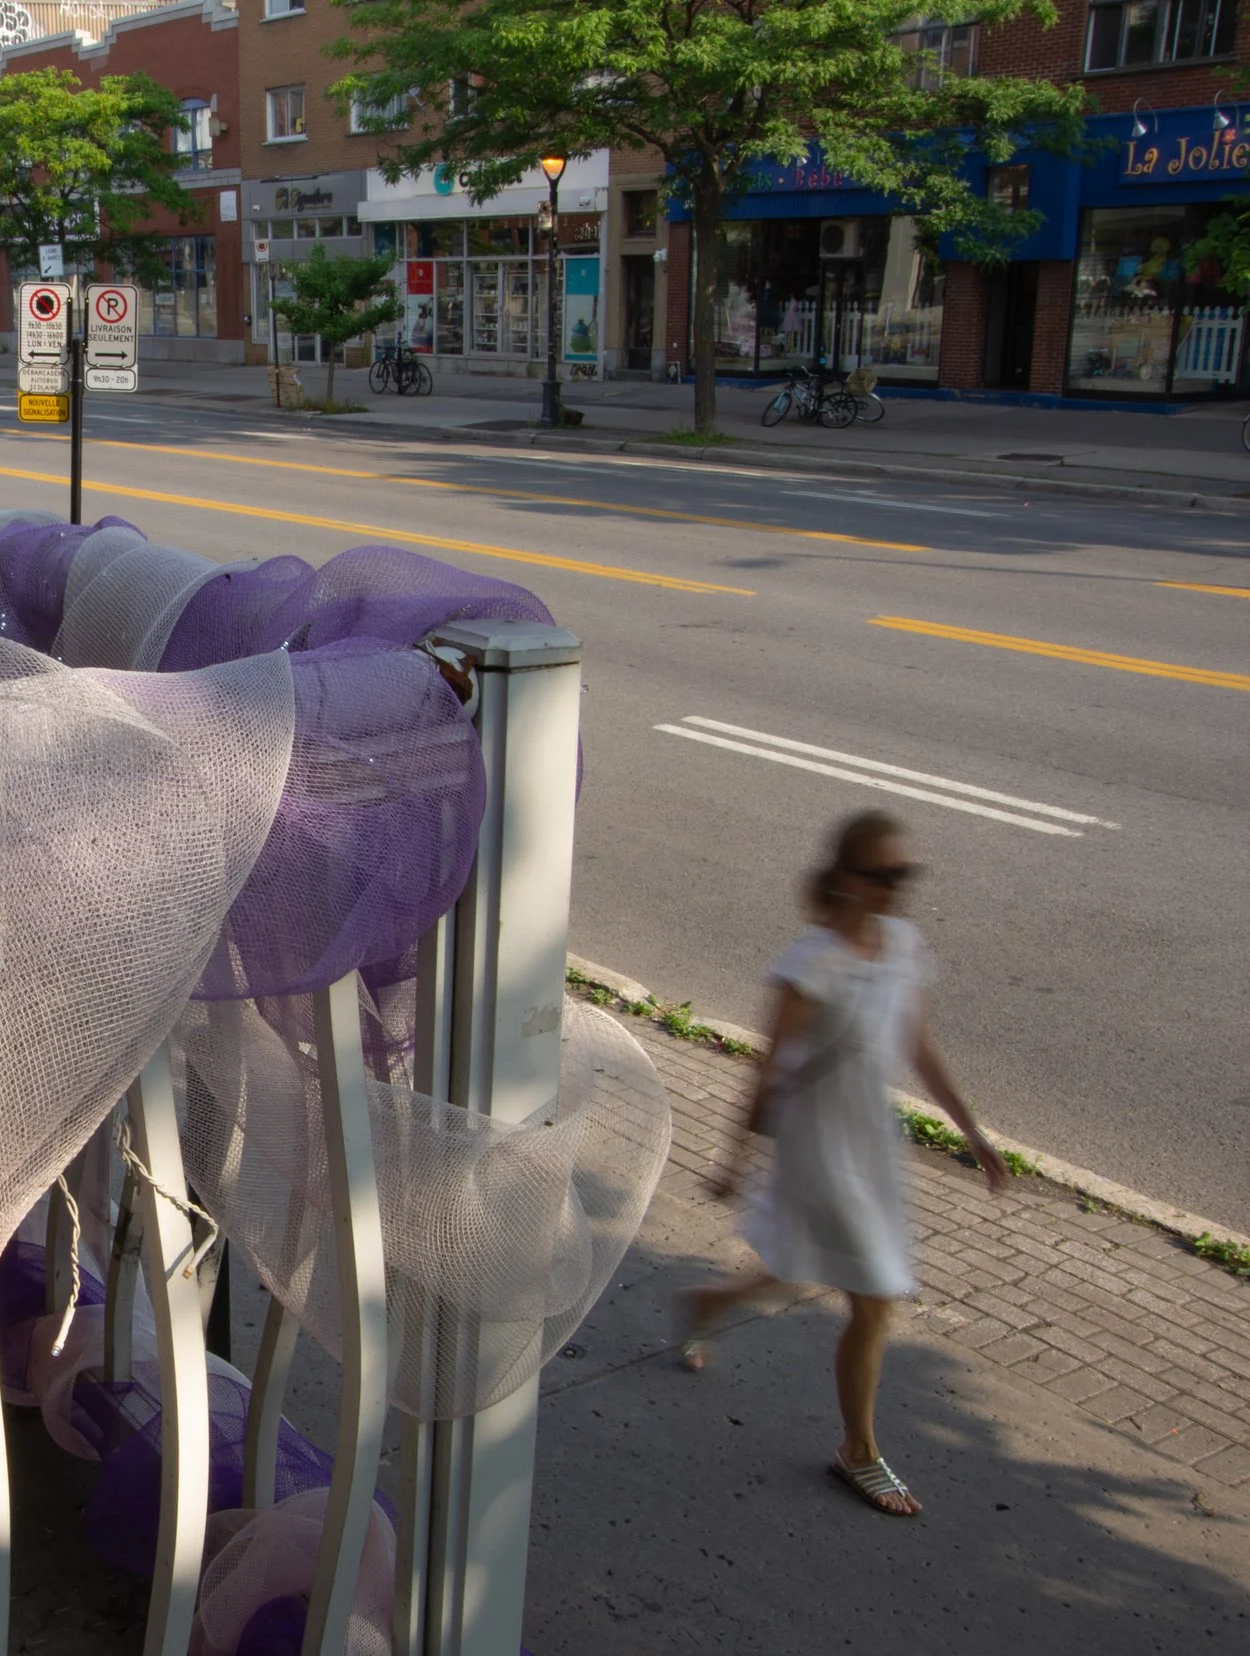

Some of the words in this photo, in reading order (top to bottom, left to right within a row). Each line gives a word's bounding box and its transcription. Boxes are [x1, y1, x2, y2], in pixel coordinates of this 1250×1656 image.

[1124, 141, 1158, 176] La
[1167, 129, 1250, 176] Jolie
[90, 325, 132, 333] LIVRAISON
[88, 334, 134, 343] SEULEMENT
[27, 340, 41, 348] LUN
[48, 340, 62, 348] VEN
[28, 399, 60, 407] NOUVELLE
